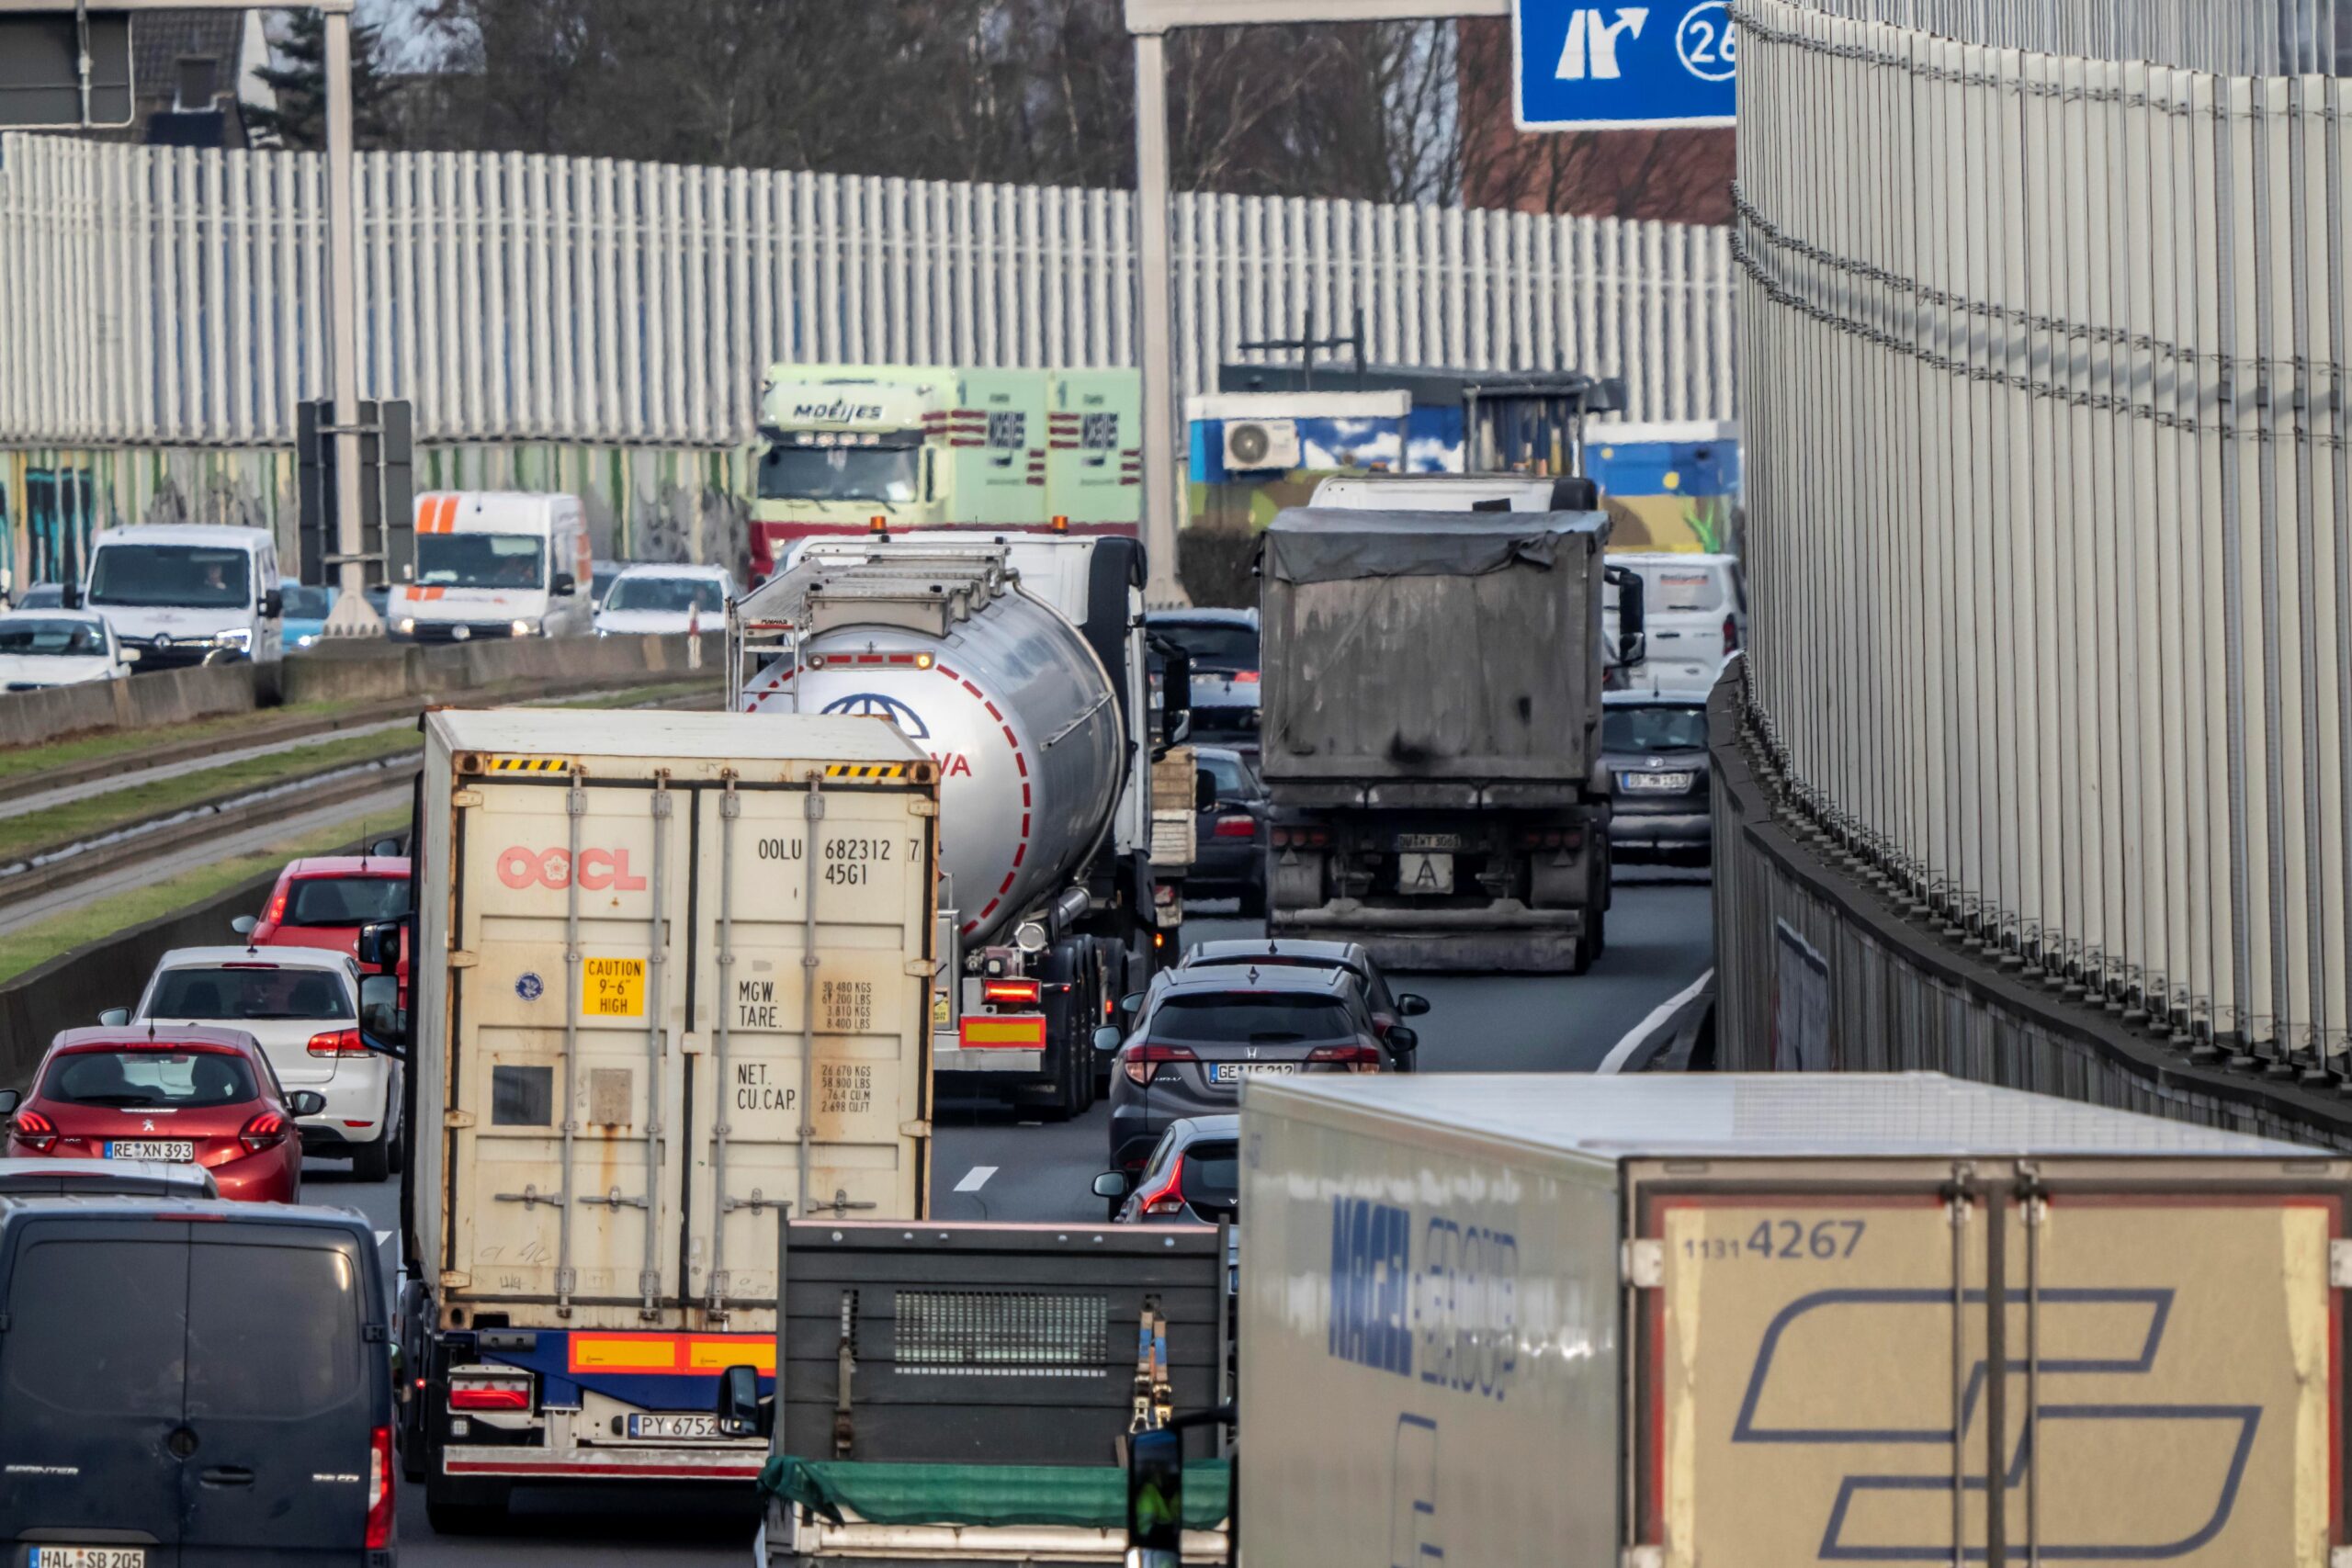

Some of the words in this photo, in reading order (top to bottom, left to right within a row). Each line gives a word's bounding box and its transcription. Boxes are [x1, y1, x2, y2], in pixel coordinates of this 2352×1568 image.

[1689, 20, 1736, 62] 26
[759, 839, 802, 860] OOLU
[825, 839, 890, 861] 682312
[910, 839, 919, 861] 7
[497, 846, 647, 891] OOCL
[825, 863, 866, 886] 45G1
[1415, 859, 1438, 887] A
[588, 960, 641, 976] CAUTION
[739, 981, 778, 1002] MGW.
[855, 982, 872, 993] KGS
[600, 998, 628, 1014] HIGH
[855, 994, 871, 1005] LBS
[739, 1005, 783, 1028] TARE.
[855, 1006, 871, 1017] KGS
[854, 1018, 871, 1029] LBS
[738, 1064, 772, 1085] NET.
[855, 1066, 871, 1077] KGS
[1218, 1066, 1237, 1078] GE
[855, 1077, 871, 1089] LBS
[114, 1143, 133, 1157] RE
[142, 1144, 162, 1157] XN
[164, 1144, 192, 1158] 393
[1747, 1219, 1867, 1260] 4267
[642, 1417, 665, 1433] PY
[40, 1551, 73, 1568] HAL
[86, 1551, 107, 1568] SB
[111, 1552, 141, 1568] 205
